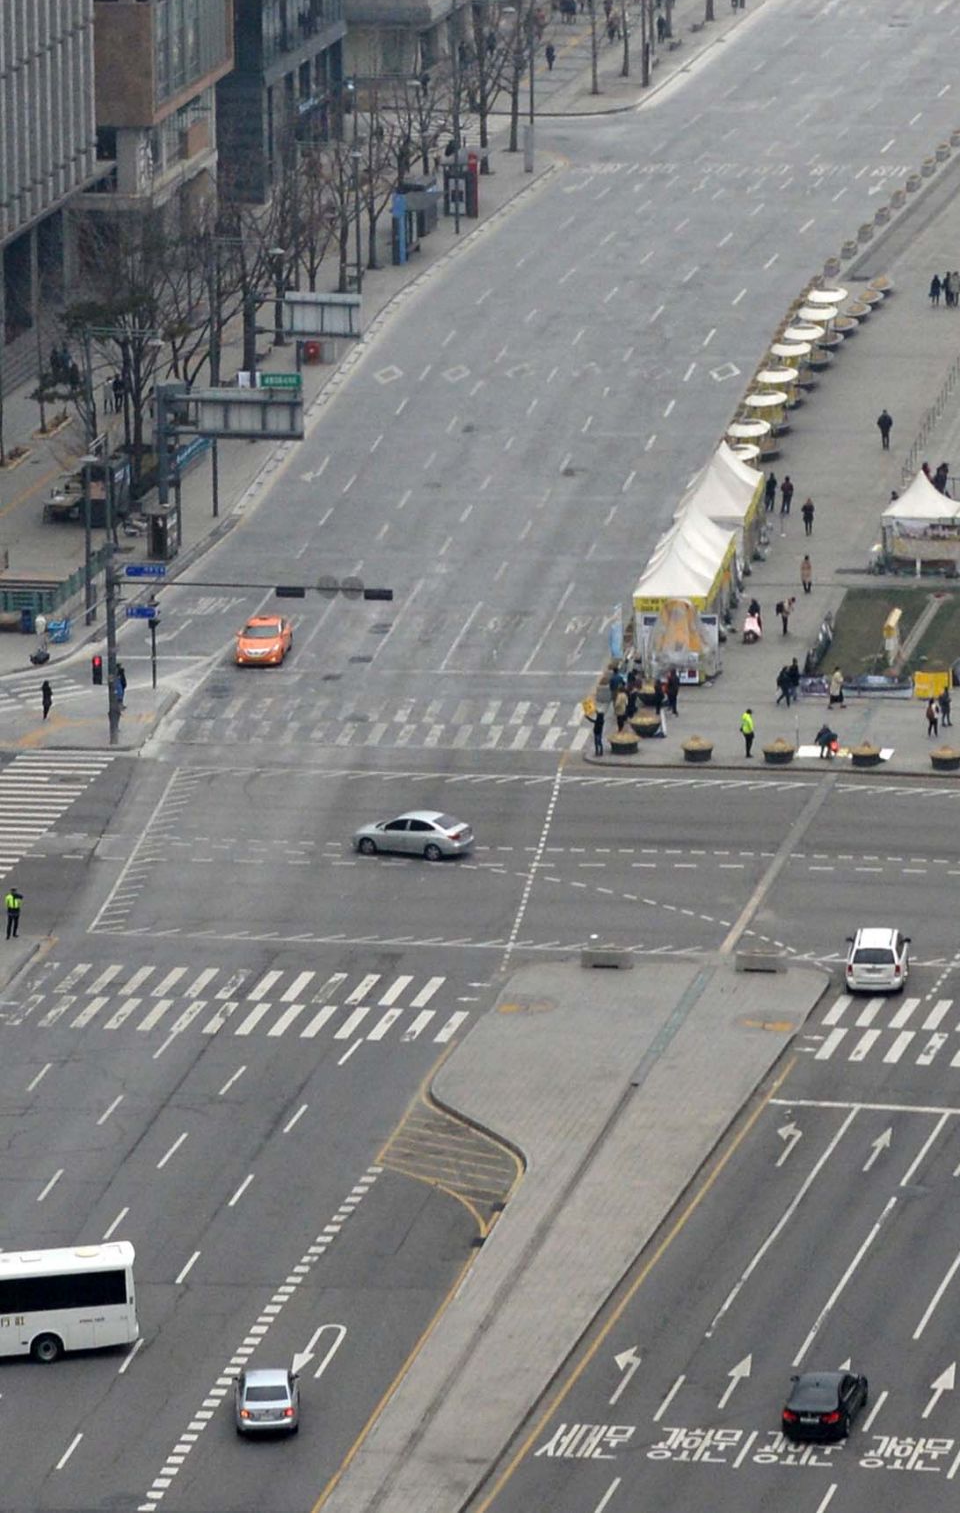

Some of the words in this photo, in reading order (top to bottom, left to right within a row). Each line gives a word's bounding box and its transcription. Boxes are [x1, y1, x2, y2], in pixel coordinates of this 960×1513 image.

[534, 1423, 637, 1459] 서대문
[646, 1427, 743, 1463] 광화문
[859, 1435, 954, 1472] 광화문
